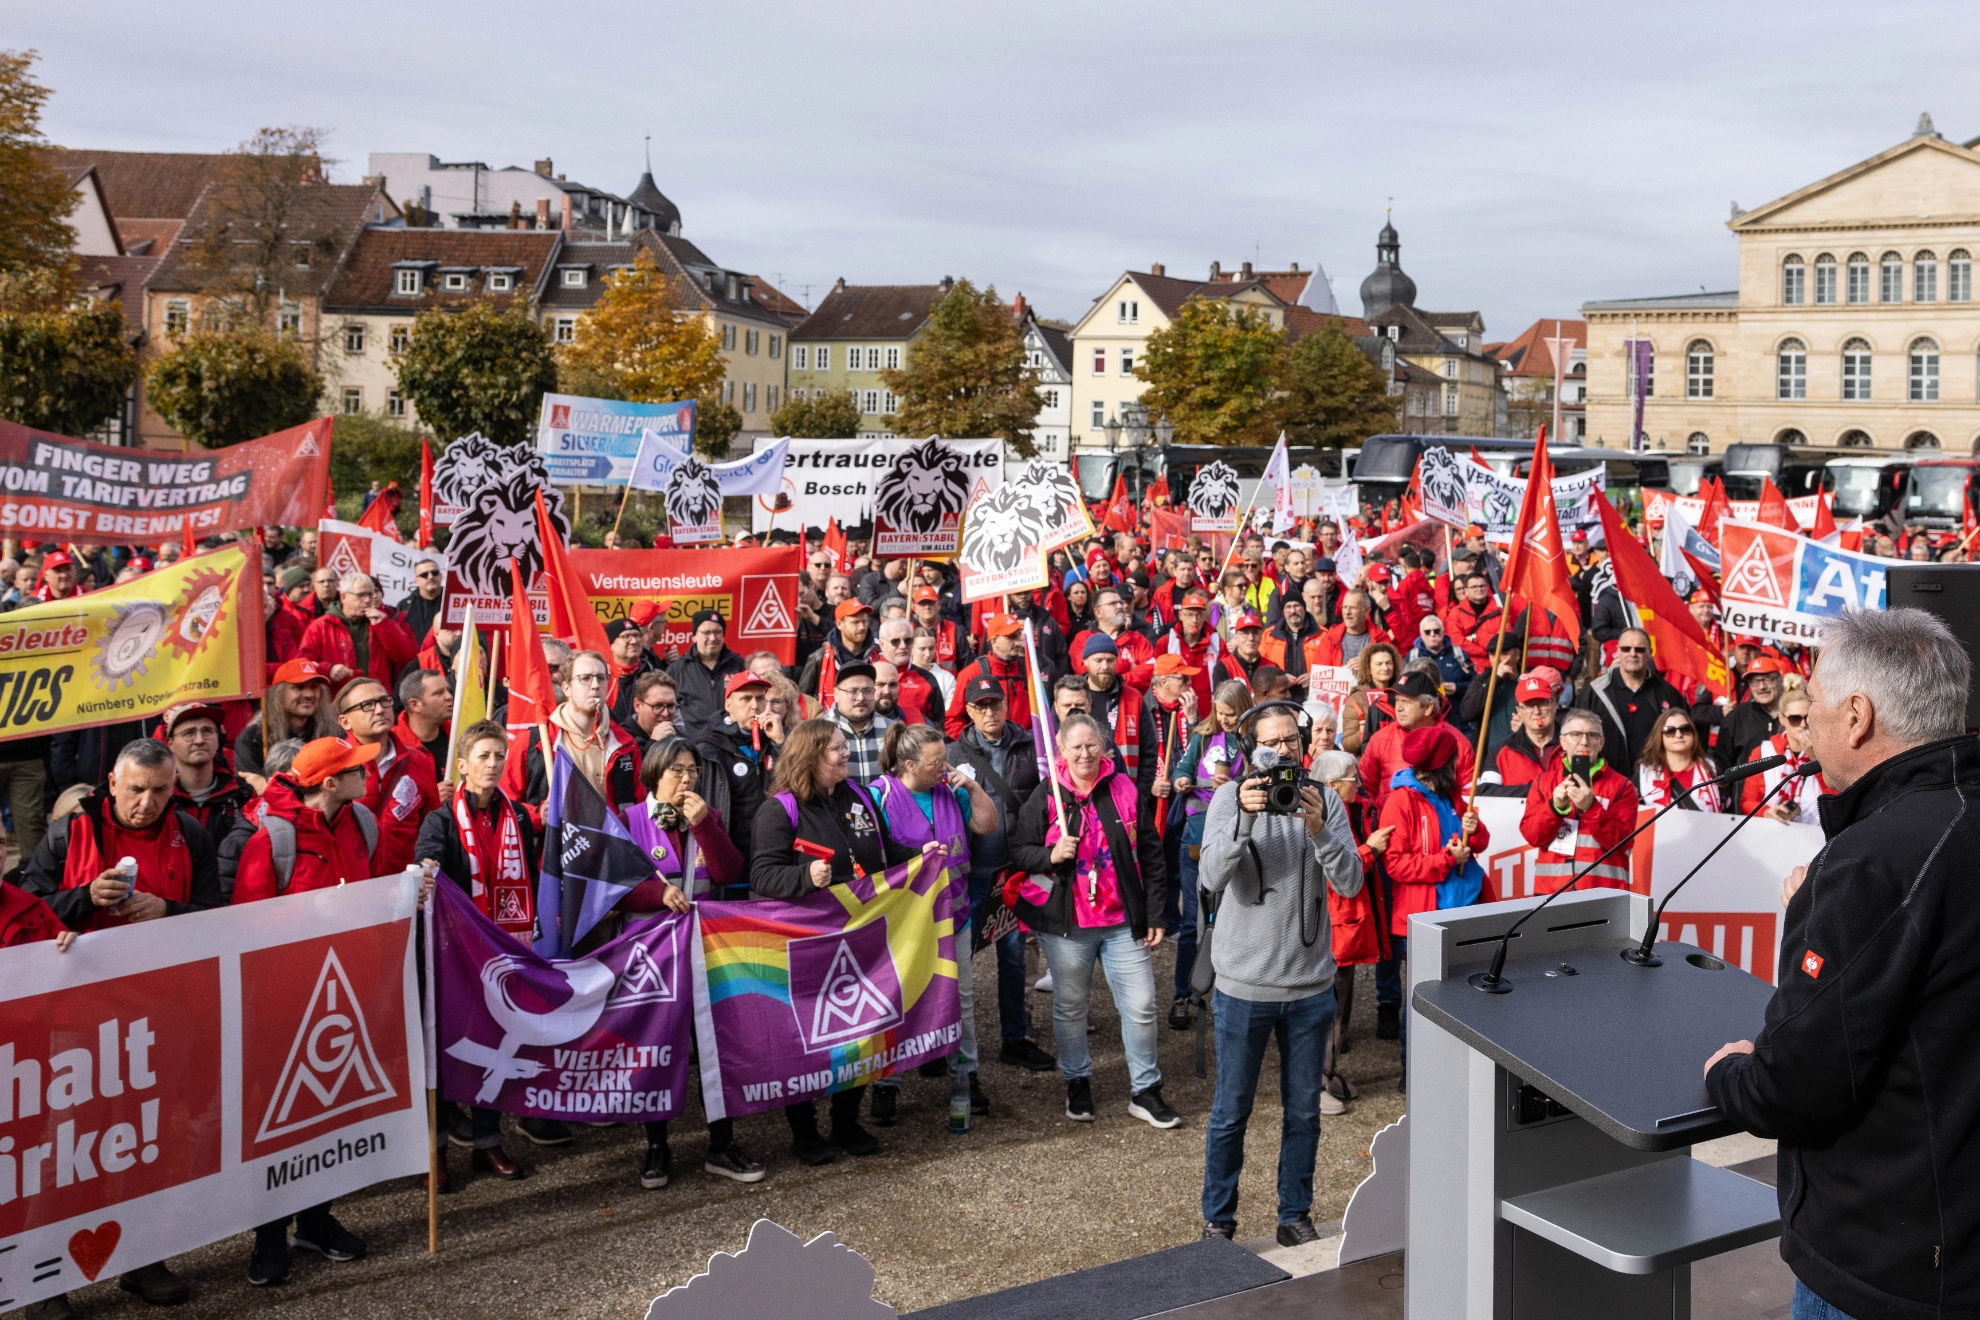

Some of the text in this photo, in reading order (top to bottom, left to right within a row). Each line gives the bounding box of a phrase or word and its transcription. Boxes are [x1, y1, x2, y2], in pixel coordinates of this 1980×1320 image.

[34, 442, 211, 485] FINGER WEG
[60, 472, 247, 508] TARIFVERTRAG
[805, 480, 867, 496] Bosch
[0, 502, 91, 530] SONST
[880, 532, 956, 544] BAYERN:STABIL
[933, 543, 955, 551] ALLES
[590, 573, 723, 590] Vertrauensleute
[748, 584, 791, 630] IGM
[77, 697, 135, 714] Nürnberg
[816, 948, 893, 1039] IGM
[264, 963, 386, 1132] IGM
[553, 1042, 673, 1070] VIELFÄLTIG
[742, 1019, 963, 1103] WIR SIND METALLERINNEN
[0, 1016, 157, 1126] halt
[557, 1069, 632, 1092] STARK
[524, 1086, 673, 1114] SOLIDARISCH
[266, 1131, 386, 1191] München
